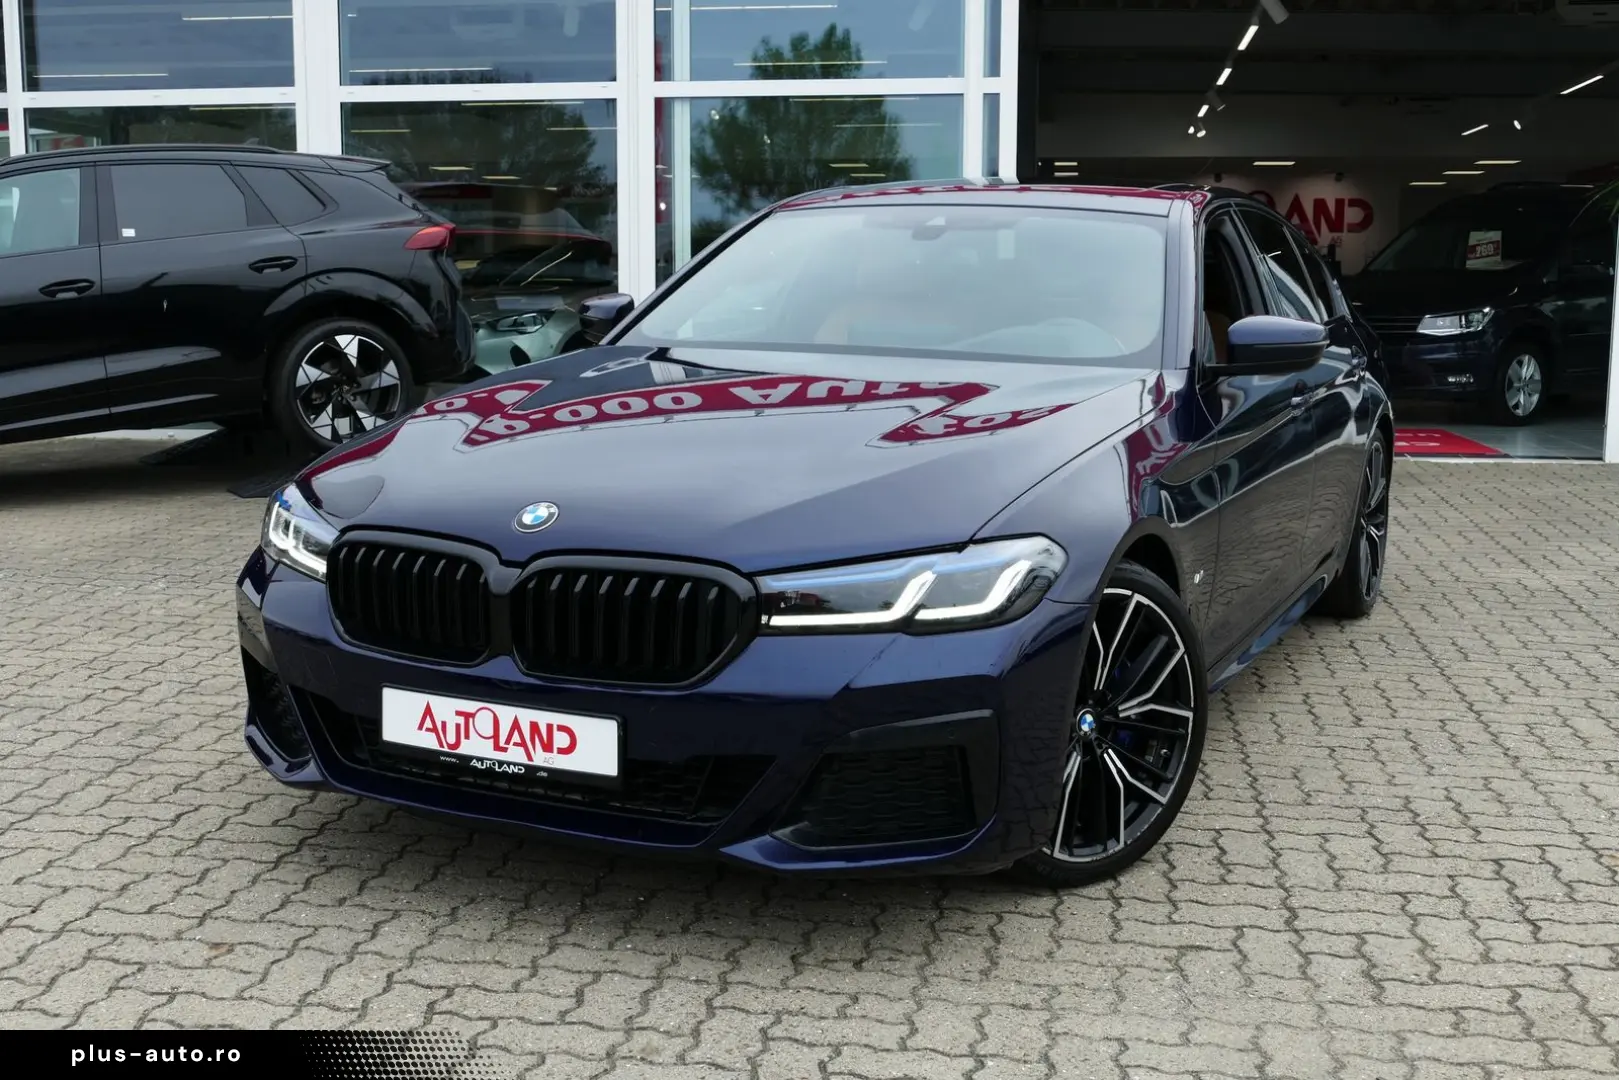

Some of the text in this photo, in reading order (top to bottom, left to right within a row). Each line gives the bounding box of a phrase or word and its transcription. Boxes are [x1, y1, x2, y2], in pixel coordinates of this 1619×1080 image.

[417, 700, 578, 762] AUTOLAND
[470, 758, 526, 775] AUTOLAND
[543, 756, 555, 766] AG
